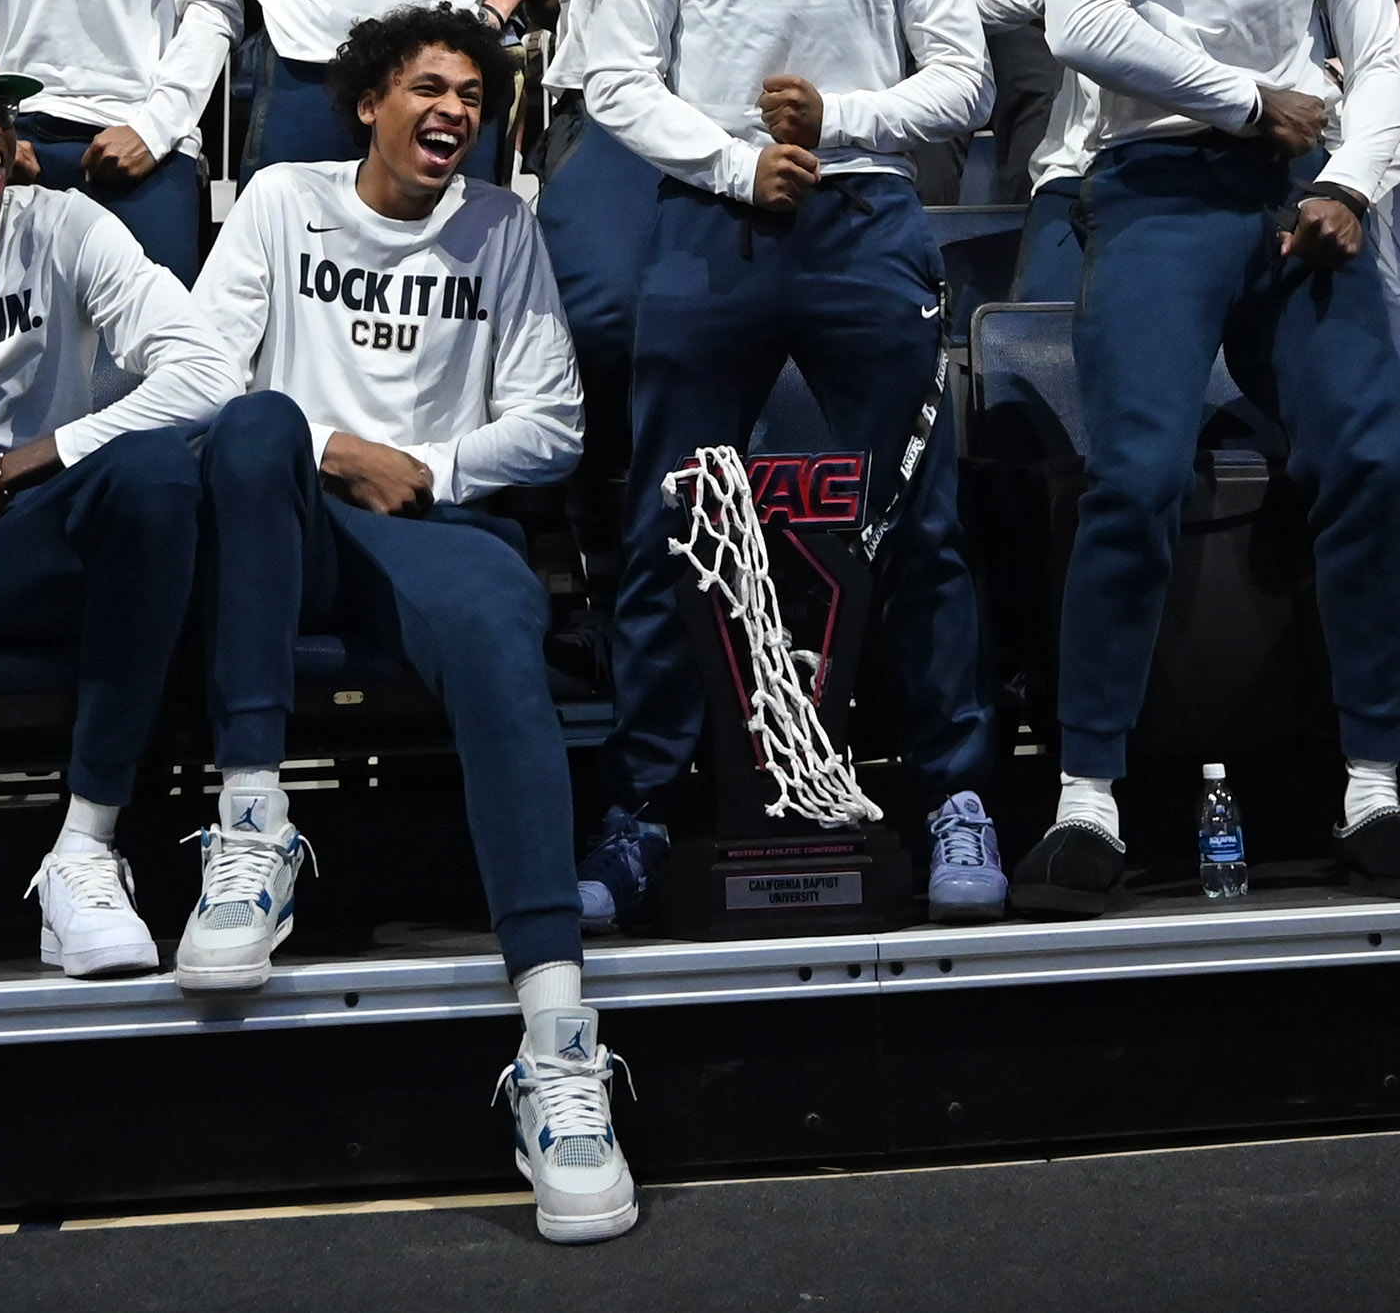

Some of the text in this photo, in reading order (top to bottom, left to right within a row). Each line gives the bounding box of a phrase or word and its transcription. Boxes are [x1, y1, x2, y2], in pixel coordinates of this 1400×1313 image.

[299, 252, 489, 322] LOCK IT IN.
[351, 320, 419, 352] CBU
[727, 849, 765, 858] WESTERN
[765, 847, 802, 856] ATHLETIC
[748, 876, 839, 892] CALIFORNIA BAPTIST
[769, 890, 820, 904] UNIVERSITY
